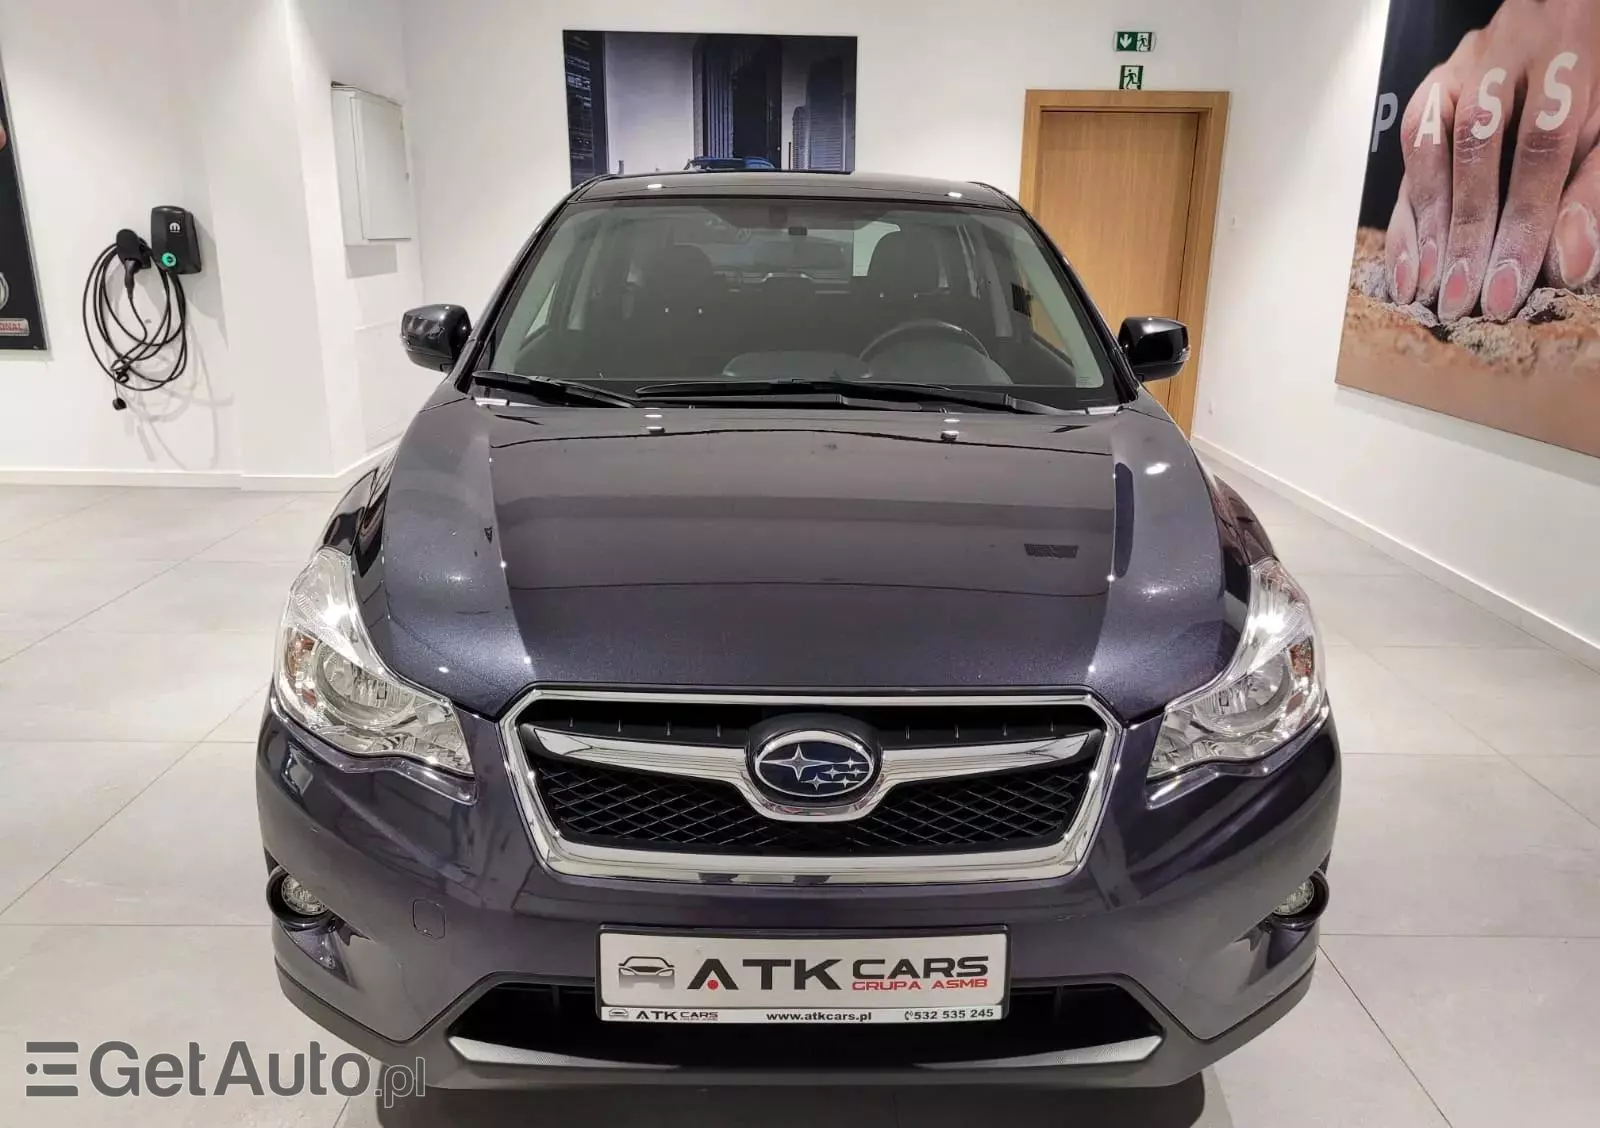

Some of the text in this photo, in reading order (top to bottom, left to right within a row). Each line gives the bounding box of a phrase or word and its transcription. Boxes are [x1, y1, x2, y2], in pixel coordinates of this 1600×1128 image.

[1371, 51, 1578, 153] PASS
[687, 956, 989, 990] ATK CARS
[852, 980, 922, 991] GRUPA
[636, 1010, 678, 1020] ATK
[766, 1012, 872, 1022] www.atkcars.pl
[913, 1009, 994, 1020] 532 535 245
